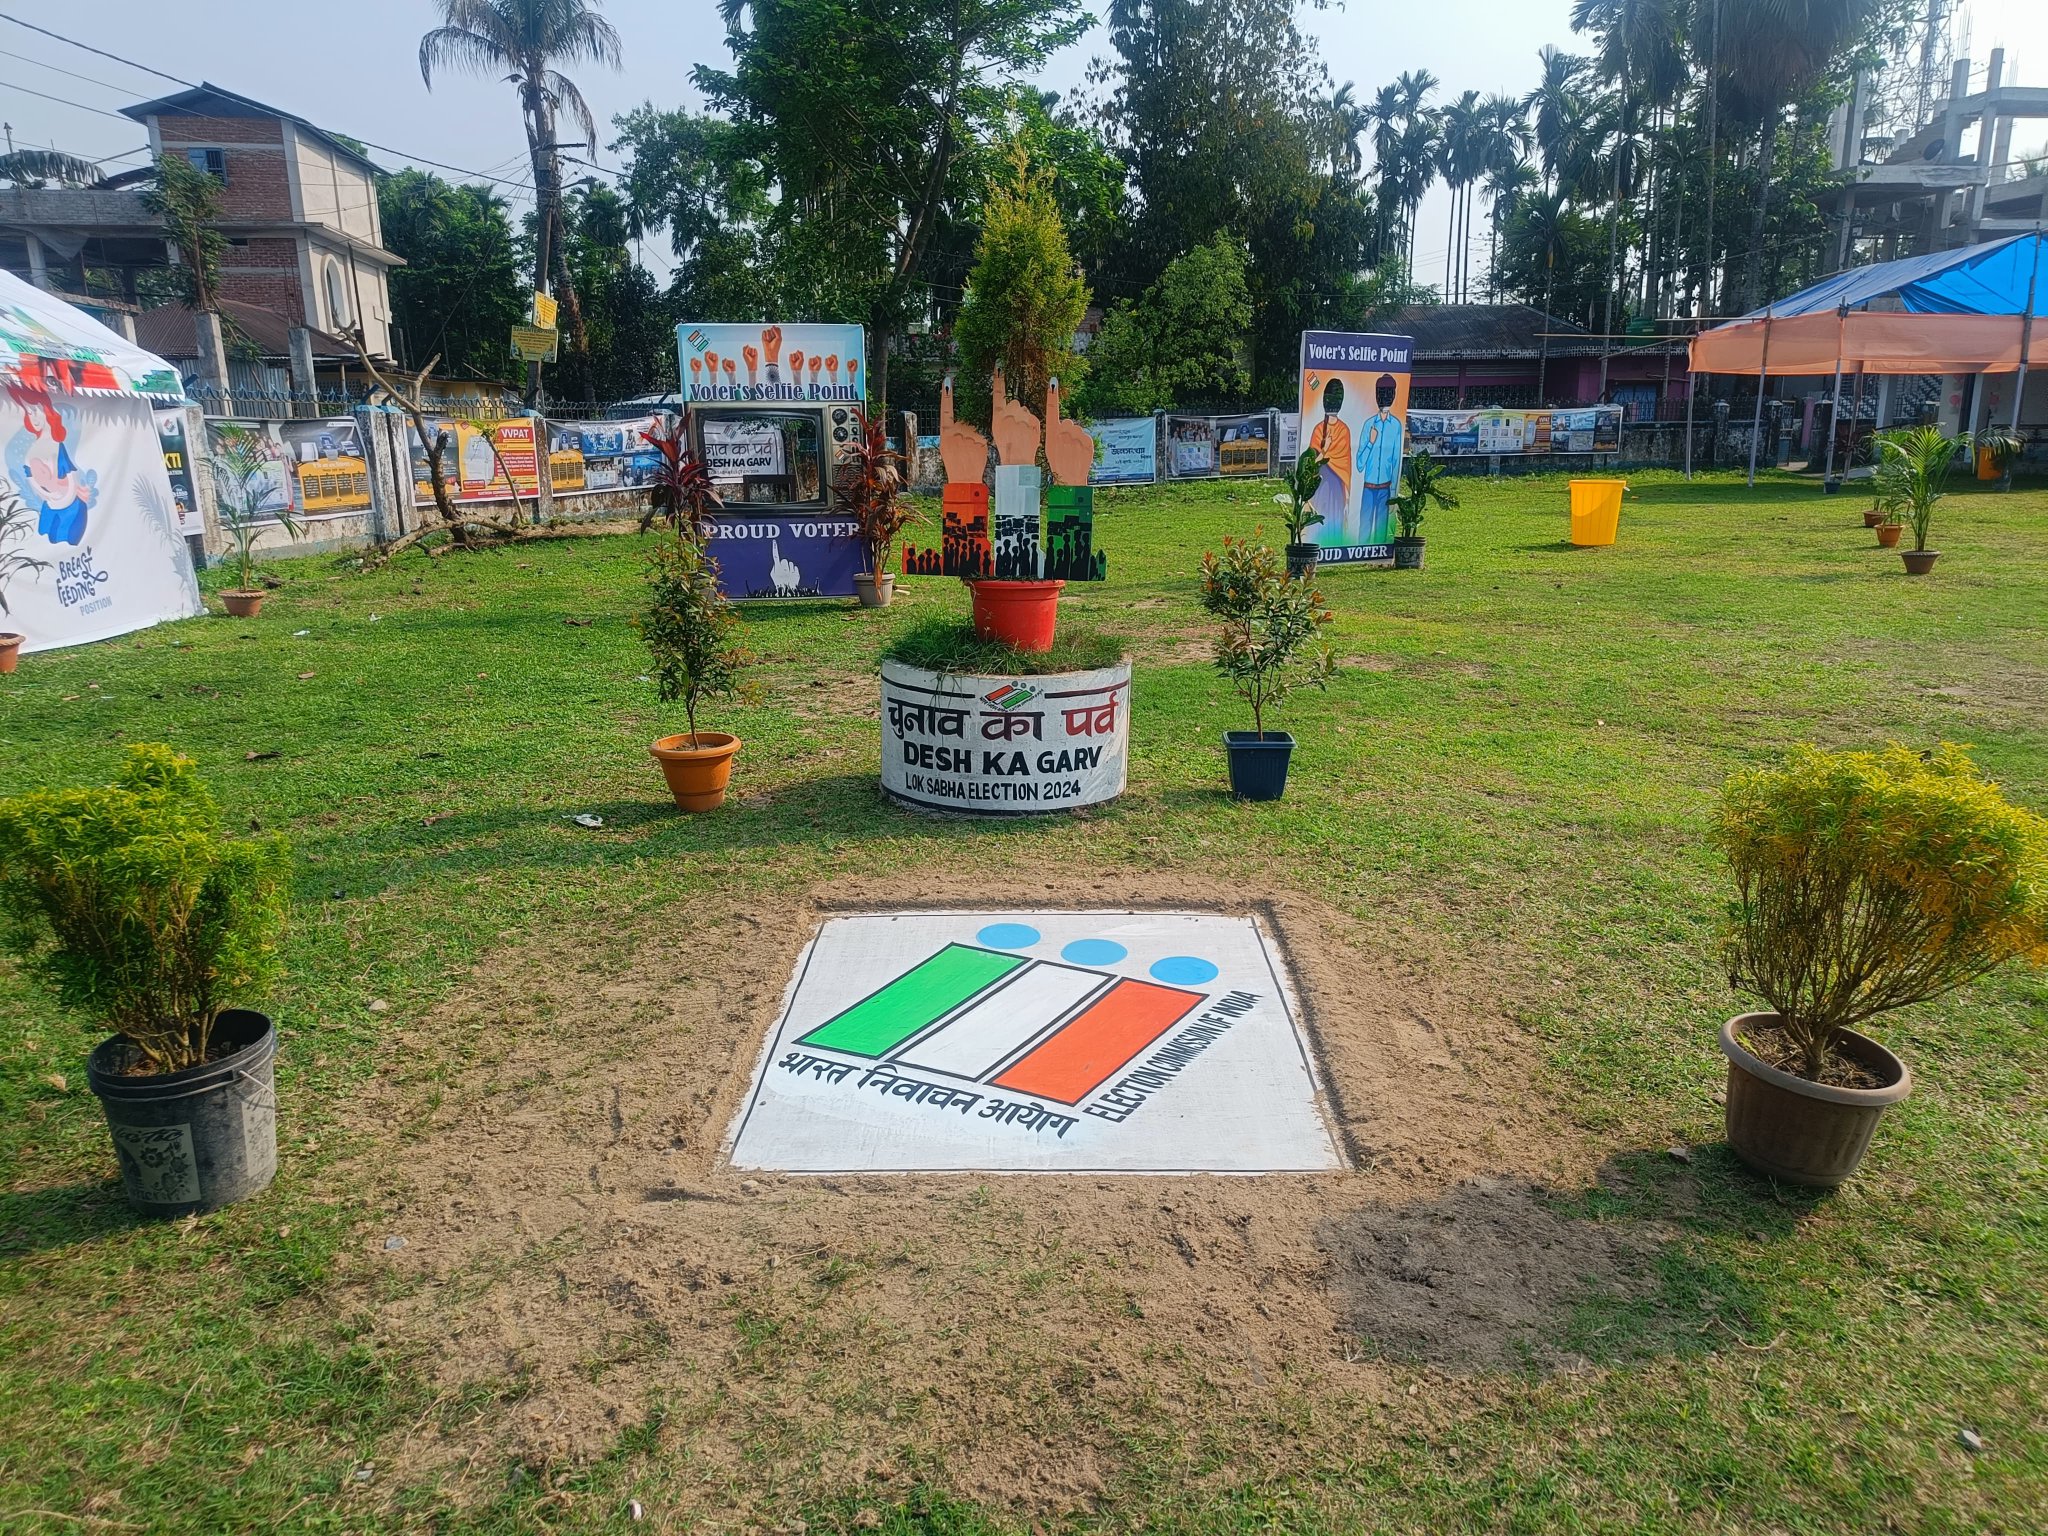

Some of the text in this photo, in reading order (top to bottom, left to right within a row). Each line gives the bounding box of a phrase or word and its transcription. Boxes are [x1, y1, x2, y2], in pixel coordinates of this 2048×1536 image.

[1309, 343, 1408, 363] Voter's Selfie Point
[690, 382, 856, 400] Voter's Selfie Point
[501, 428, 529, 438] VVPAT
[731, 443, 750, 455] का
[706, 457, 772, 468] DESH KA GARV
[704, 523, 780, 539] PROUD
[1347, 545, 1388, 559] VOTER
[59, 551, 108, 582] BREAST
[80, 596, 113, 616] POSITION
[887, 697, 971, 740] चुनाव
[979, 711, 1046, 742] का
[1061, 690, 1120, 737] पर्व
[904, 741, 1103, 776] DESH KA GARV
[905, 772, 1082, 801] LOK SABHA ELECTION 2024
[1209, 990, 1264, 1018] INDIA
[1197, 1013, 1235, 1029] OF
[778, 1052, 862, 1085] भारत
[978, 1098, 1079, 1139] आयोग
[1082, 1066, 1178, 1123] ELECTION
